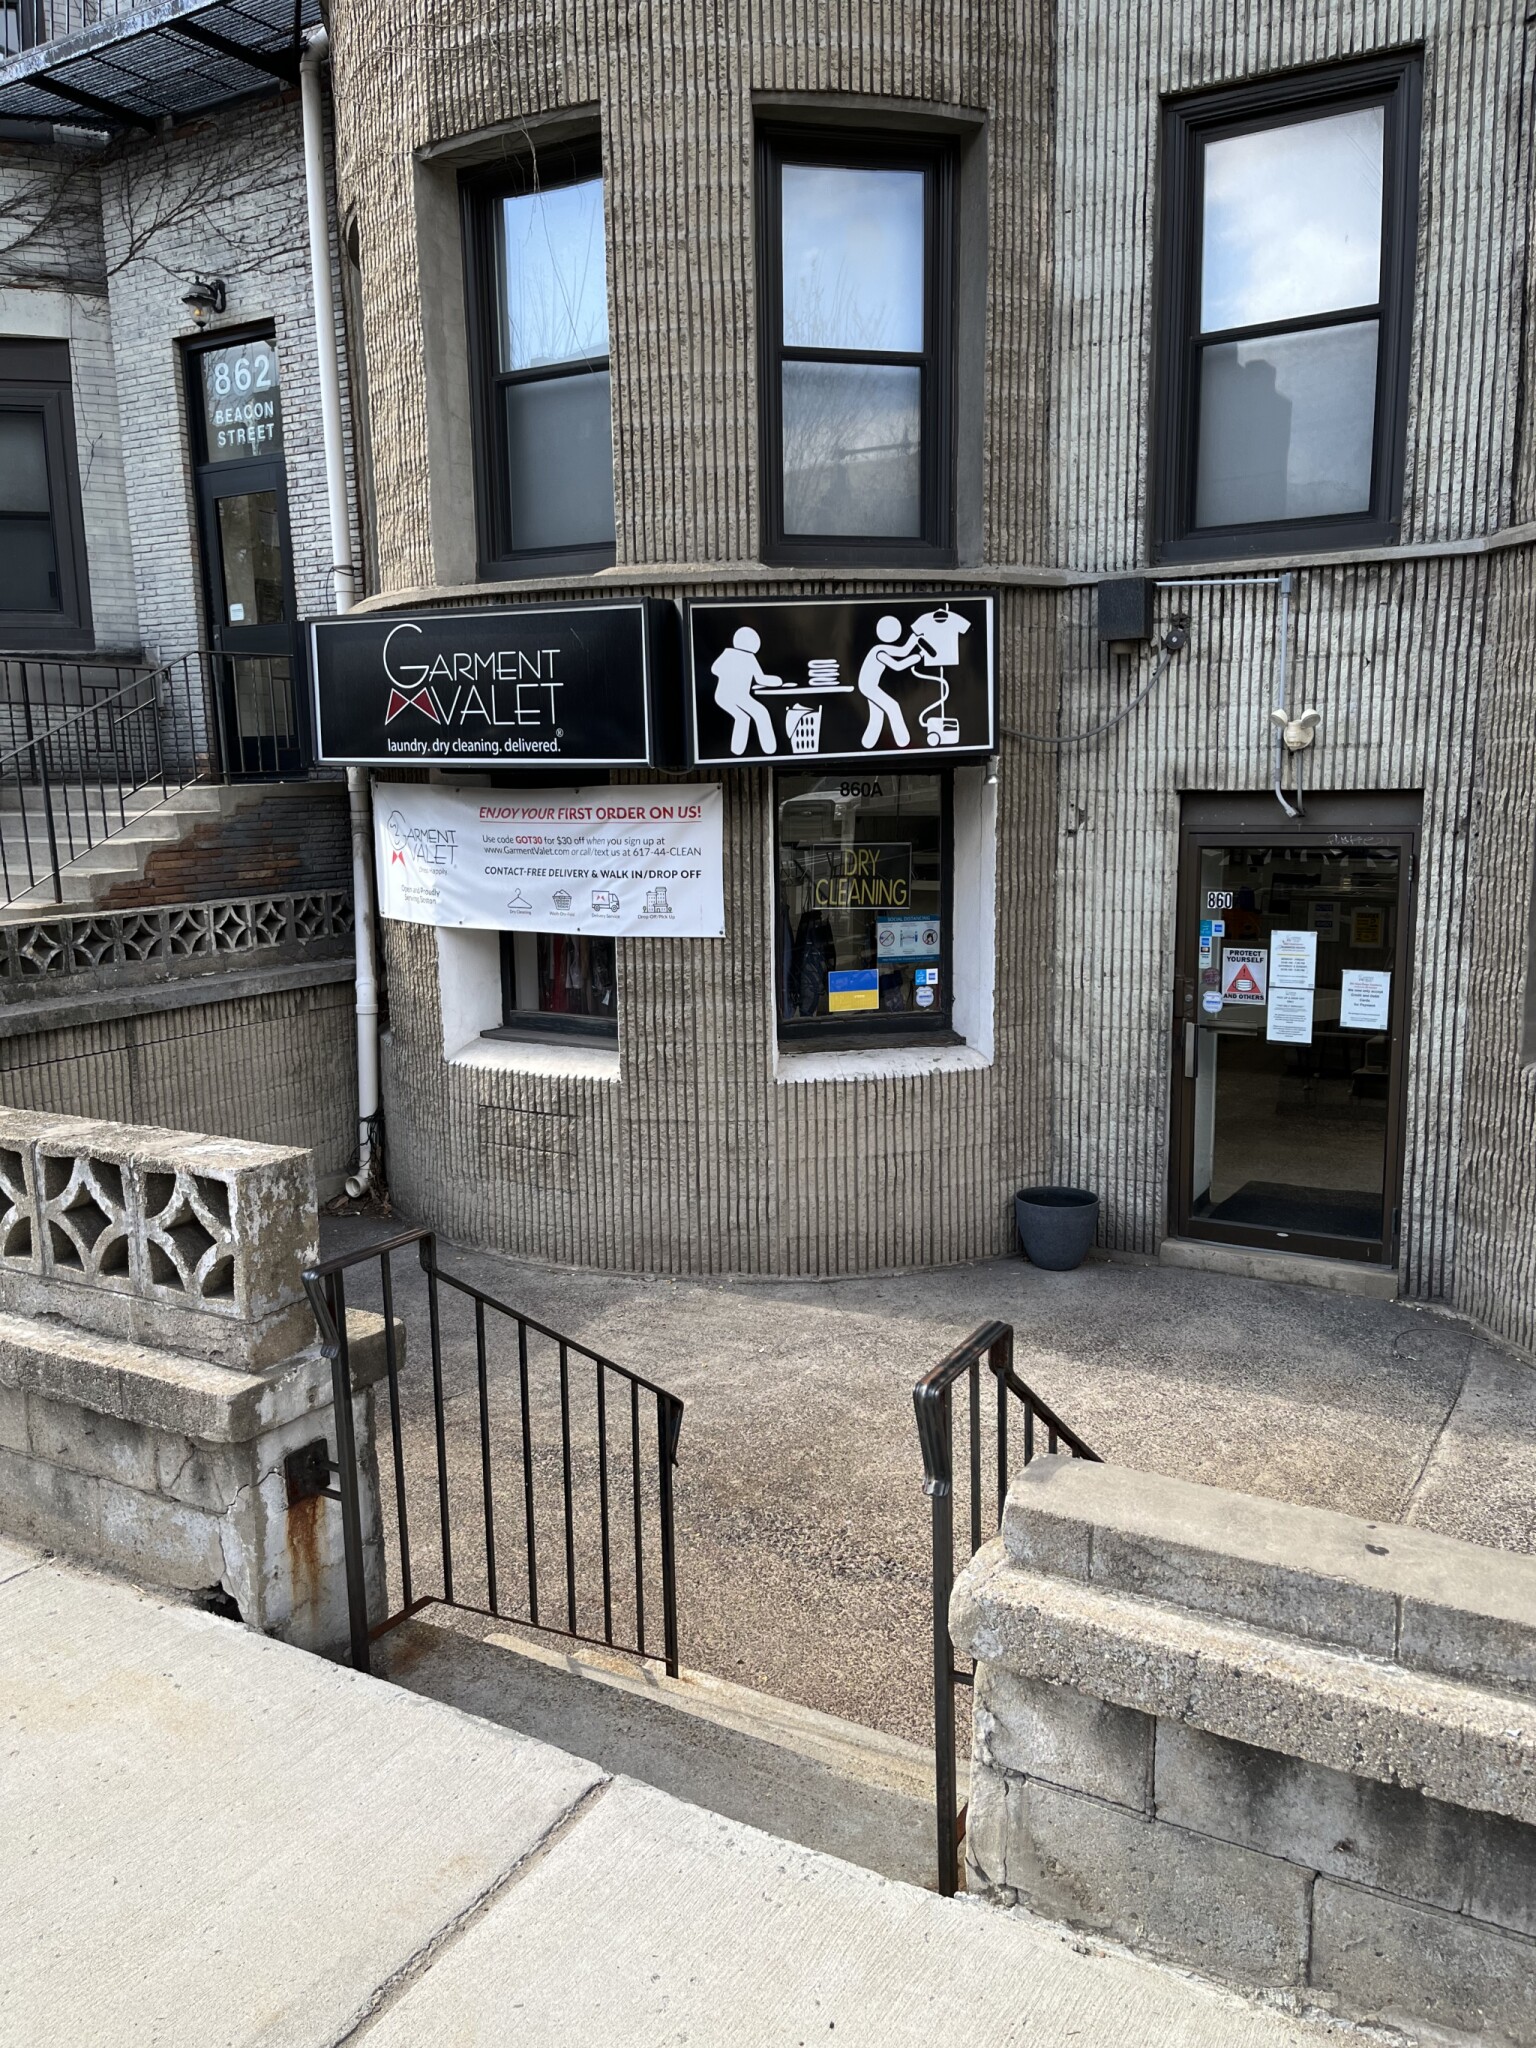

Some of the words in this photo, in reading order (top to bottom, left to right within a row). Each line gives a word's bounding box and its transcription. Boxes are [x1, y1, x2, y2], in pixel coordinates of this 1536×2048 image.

[215, 354, 271, 395] 862
[216, 401, 274, 424] BEACON
[218, 423, 274, 446] STREET
[383, 623, 561, 689] GARMENT
[430, 682, 564, 726] VALET
[387, 738, 430, 755] laundry.
[432, 738, 450, 755] dry
[452, 738, 502, 755] cleaning.
[504, 737, 561, 752] delivered.
[840, 781, 883, 797] 860A
[479, 807, 520, 819] ENJOY
[521, 808, 555, 820] YOUR
[558, 808, 593, 820] FIRST
[596, 807, 646, 820] ORDER
[650, 806, 674, 819] ON
[678, 805, 702, 819] US!
[482, 835, 496, 844] Use
[497, 835, 514, 844] code
[515, 836, 543, 845] GOT30
[544, 836, 555, 845] for
[557, 836, 573, 845] $30
[574, 836, 585, 845] off
[587, 836, 605, 845] when
[606, 838, 622, 847] you
[624, 836, 641, 847] sign
[643, 838, 654, 847] up
[656, 837, 665, 845] at
[484, 846, 570, 856] www.GarmentValet.com
[580, 847, 609, 857] call/text
[611, 849, 621, 857] us
[622, 848, 631, 857] at
[633, 847, 702, 857] 617-44-CLEAN
[408, 843, 458, 865] VALET
[844, 849, 881, 876] DRY
[484, 866, 547, 877] CONTACT-FREE
[548, 868, 590, 878] DELIVERY
[591, 870, 599, 879] &
[600, 870, 628, 879] WALK
[631, 869, 678, 880] IN/DROP
[681, 870, 702, 879] OFF
[815, 878, 907, 906] CLEANING
[1208, 892, 1232, 908] 860
